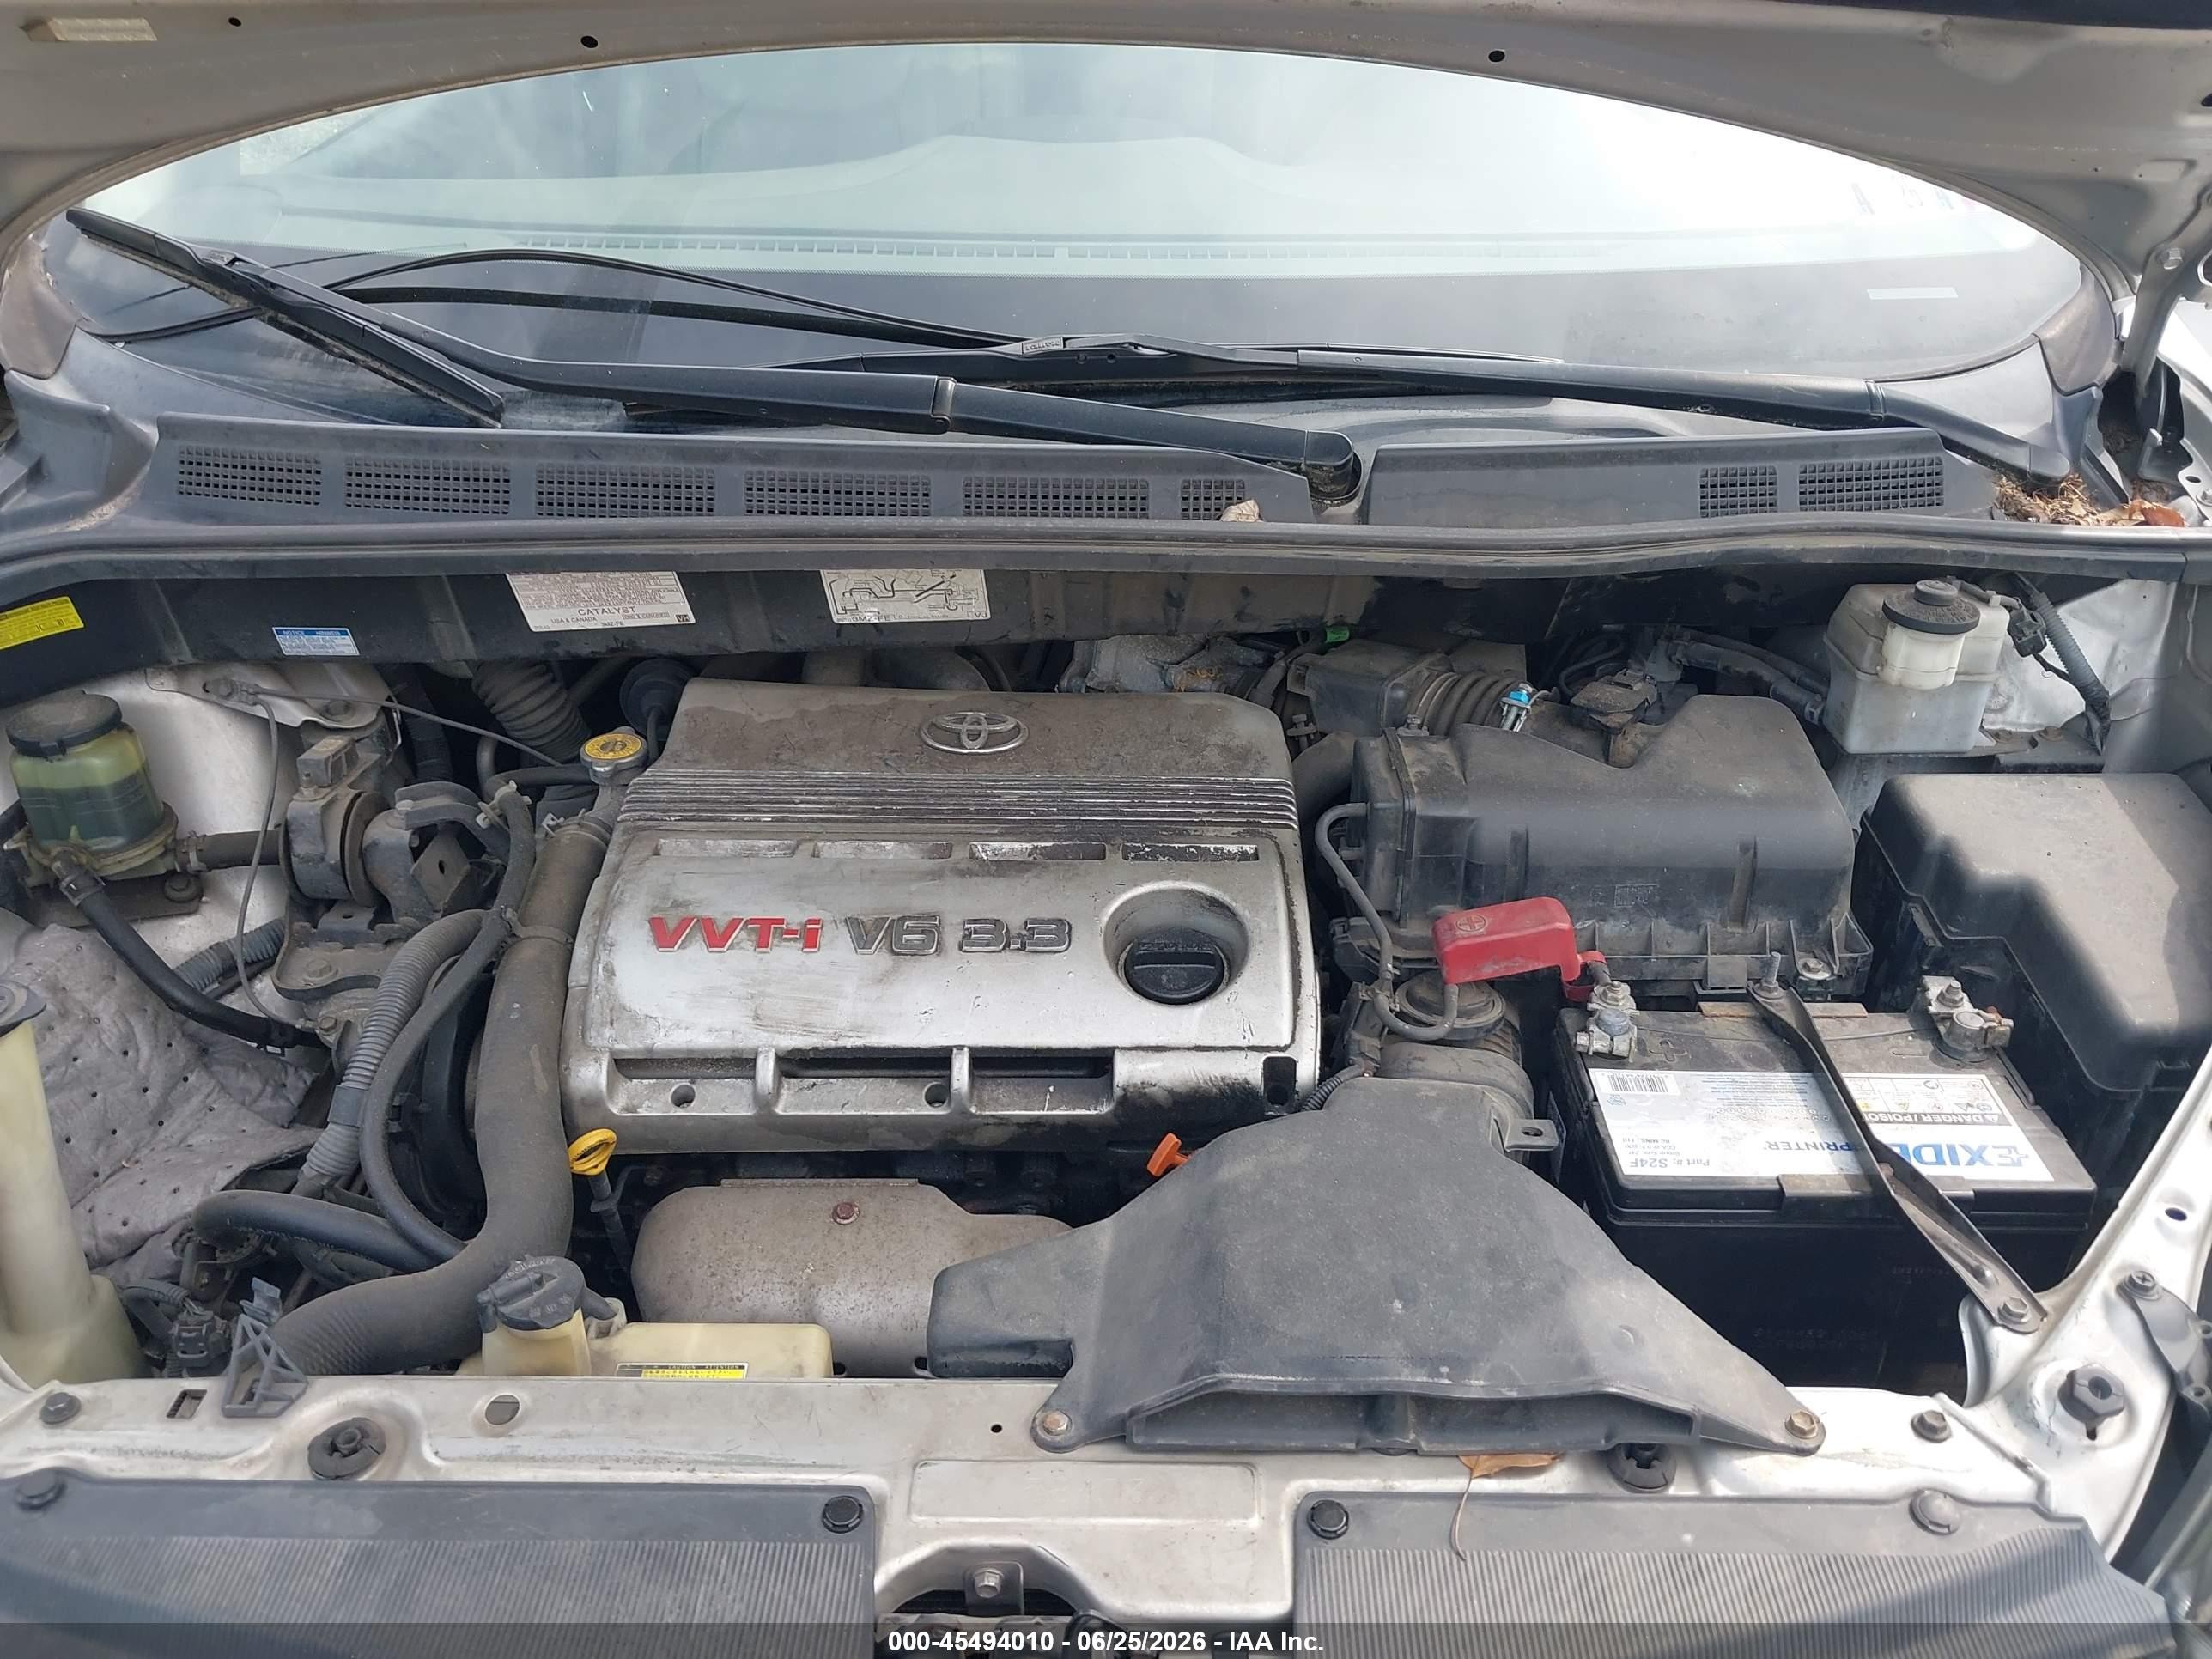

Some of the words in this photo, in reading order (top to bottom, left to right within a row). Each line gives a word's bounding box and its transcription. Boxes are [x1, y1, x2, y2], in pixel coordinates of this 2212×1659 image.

[577, 606, 636, 617] CATALYST
[647, 916, 823, 953] VVT-i
[843, 915, 941, 955] V6
[958, 918, 1073, 953] 3.3
[1920, 1113, 1982, 1123] DANGER
[1765, 1141, 1853, 1152] PRINTER
[1630, 1158, 1668, 1169] S24F
[1686, 1158, 1710, 1167] Part
